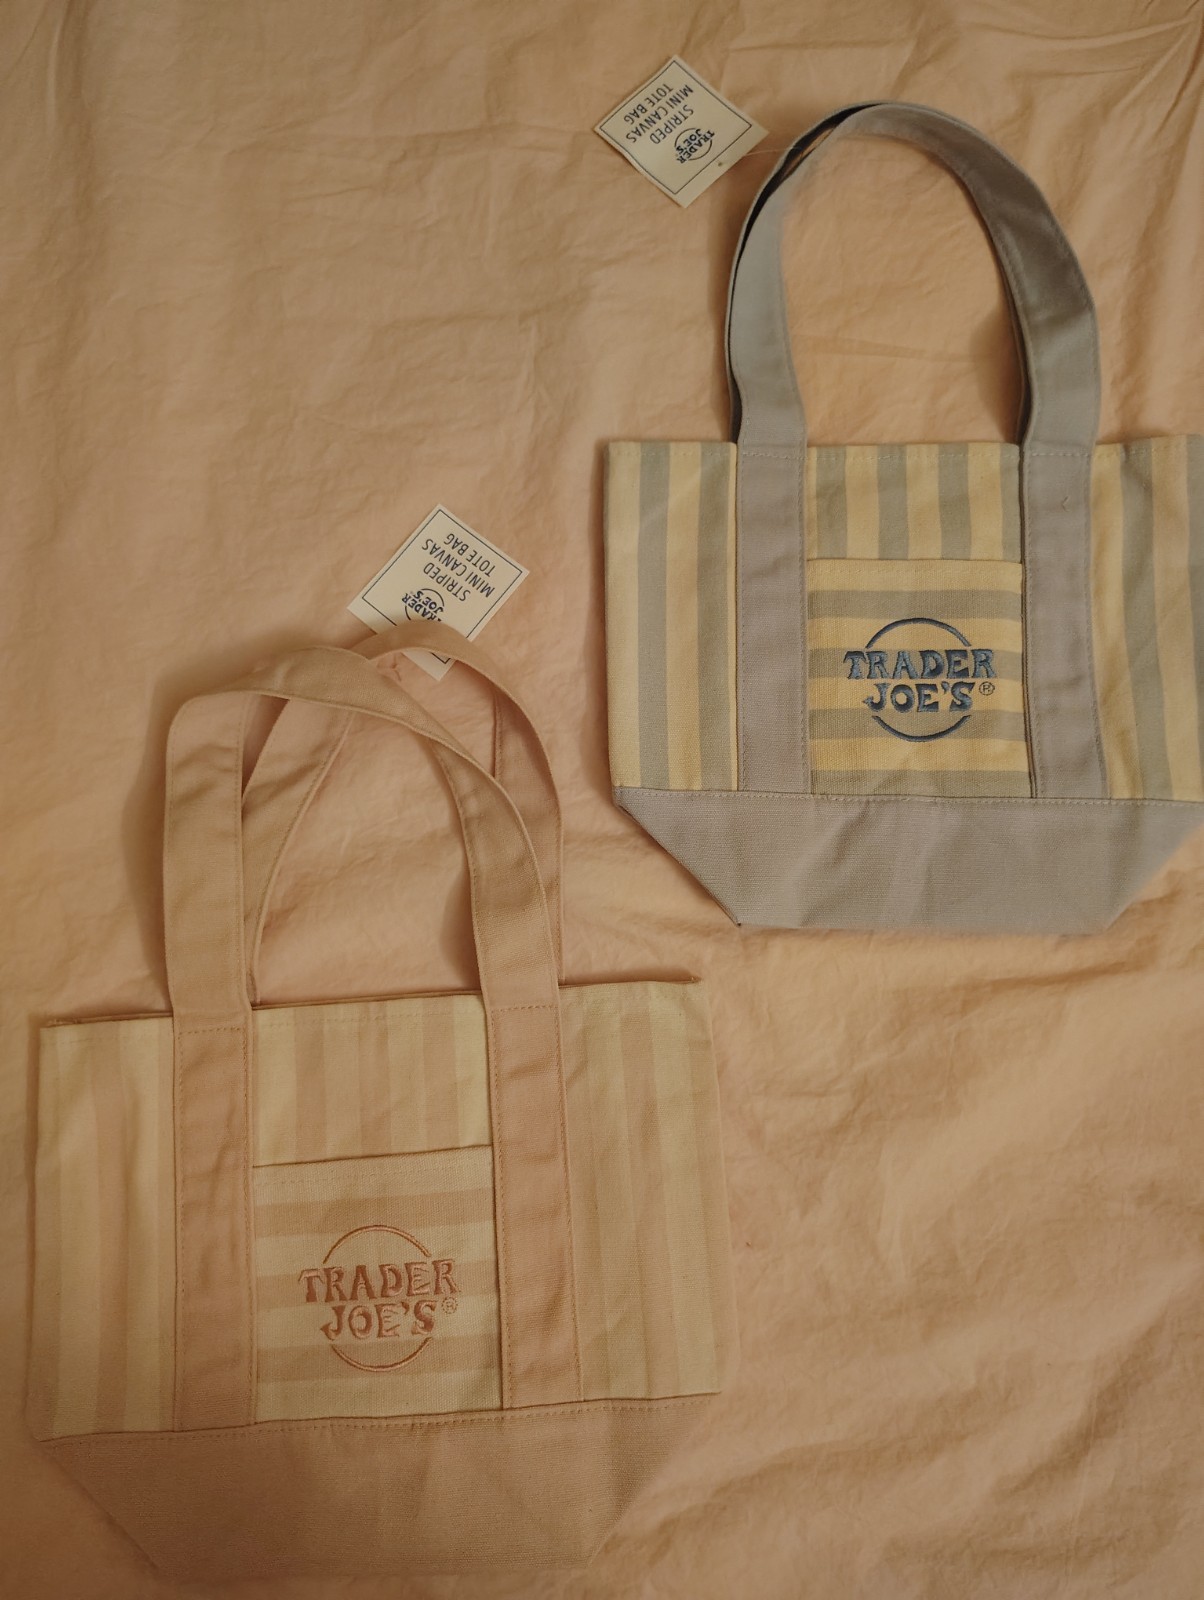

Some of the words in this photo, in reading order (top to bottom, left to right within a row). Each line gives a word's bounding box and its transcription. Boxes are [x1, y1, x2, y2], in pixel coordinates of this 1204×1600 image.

[643, 83, 674, 108] TOTE
[667, 84, 694, 110] MINI
[623, 103, 648, 125] BAG
[625, 105, 669, 143] CANVAS
[649, 104, 694, 145] STRIPED
[676, 129, 715, 164] TRADER
[421, 538, 468, 577] CANVAS
[443, 533, 469, 556] BAG
[465, 550, 496, 577] TOTE
[423, 562, 471, 602] STRIPED
[464, 571, 496, 598] MINI
[401, 593, 442, 622] RADER
[843, 648, 997, 680] TRADER
[298, 1258, 461, 1303] TRADER
